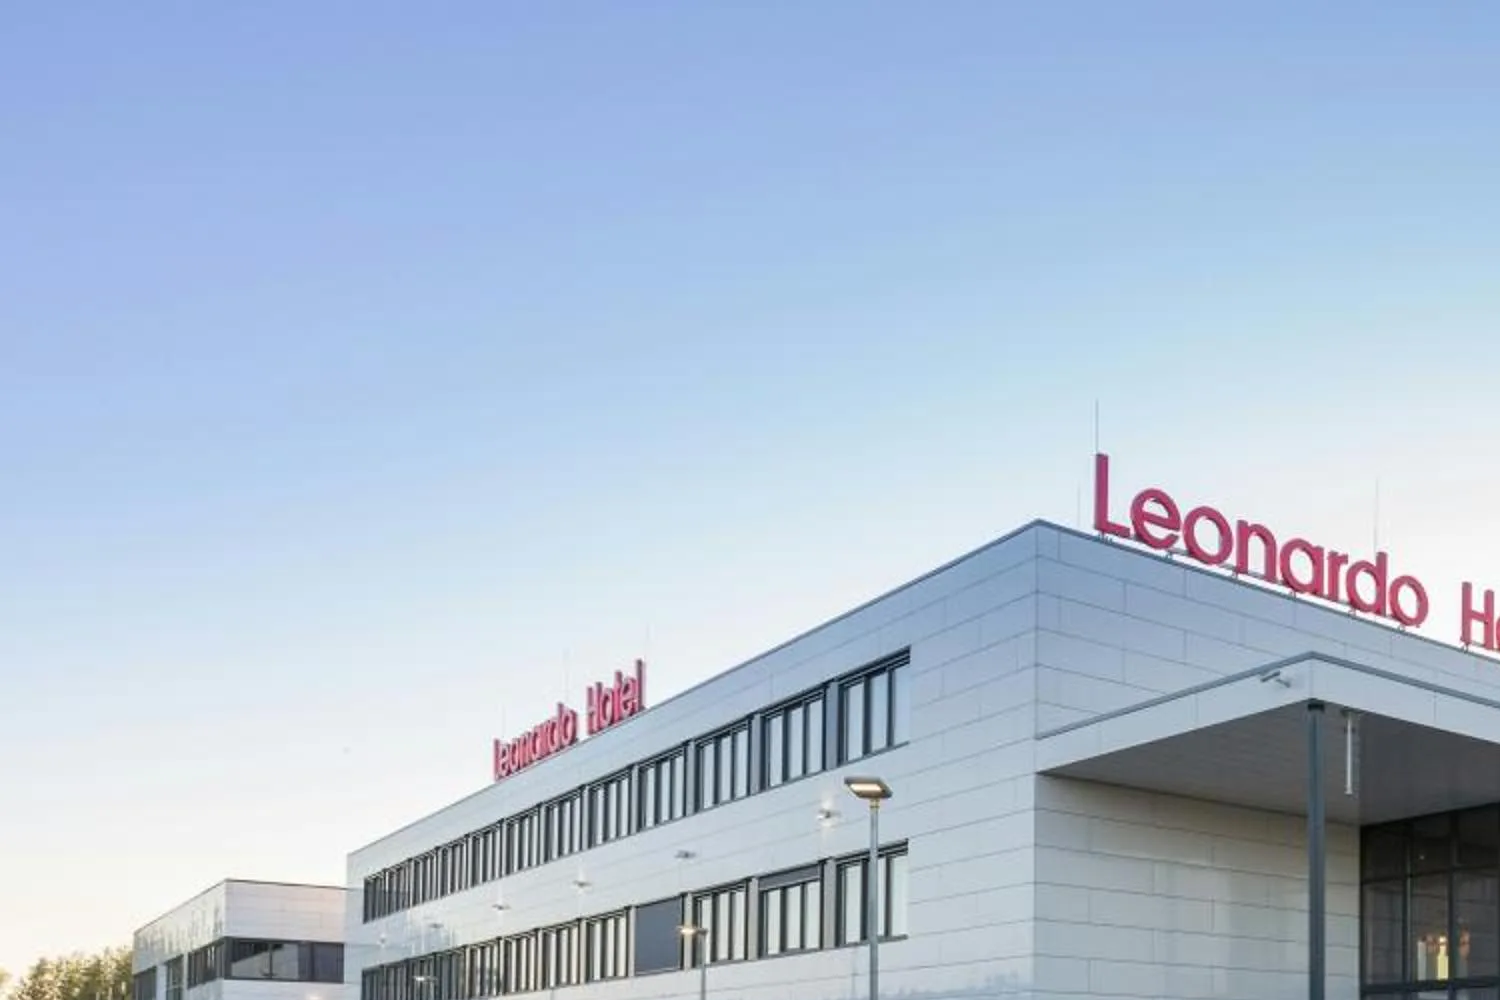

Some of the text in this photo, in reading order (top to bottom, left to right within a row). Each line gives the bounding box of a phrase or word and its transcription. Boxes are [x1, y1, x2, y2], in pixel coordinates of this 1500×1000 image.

[1094, 453, 1429, 628] Leonardo
[494, 659, 643, 780] Leonardo Hotel
